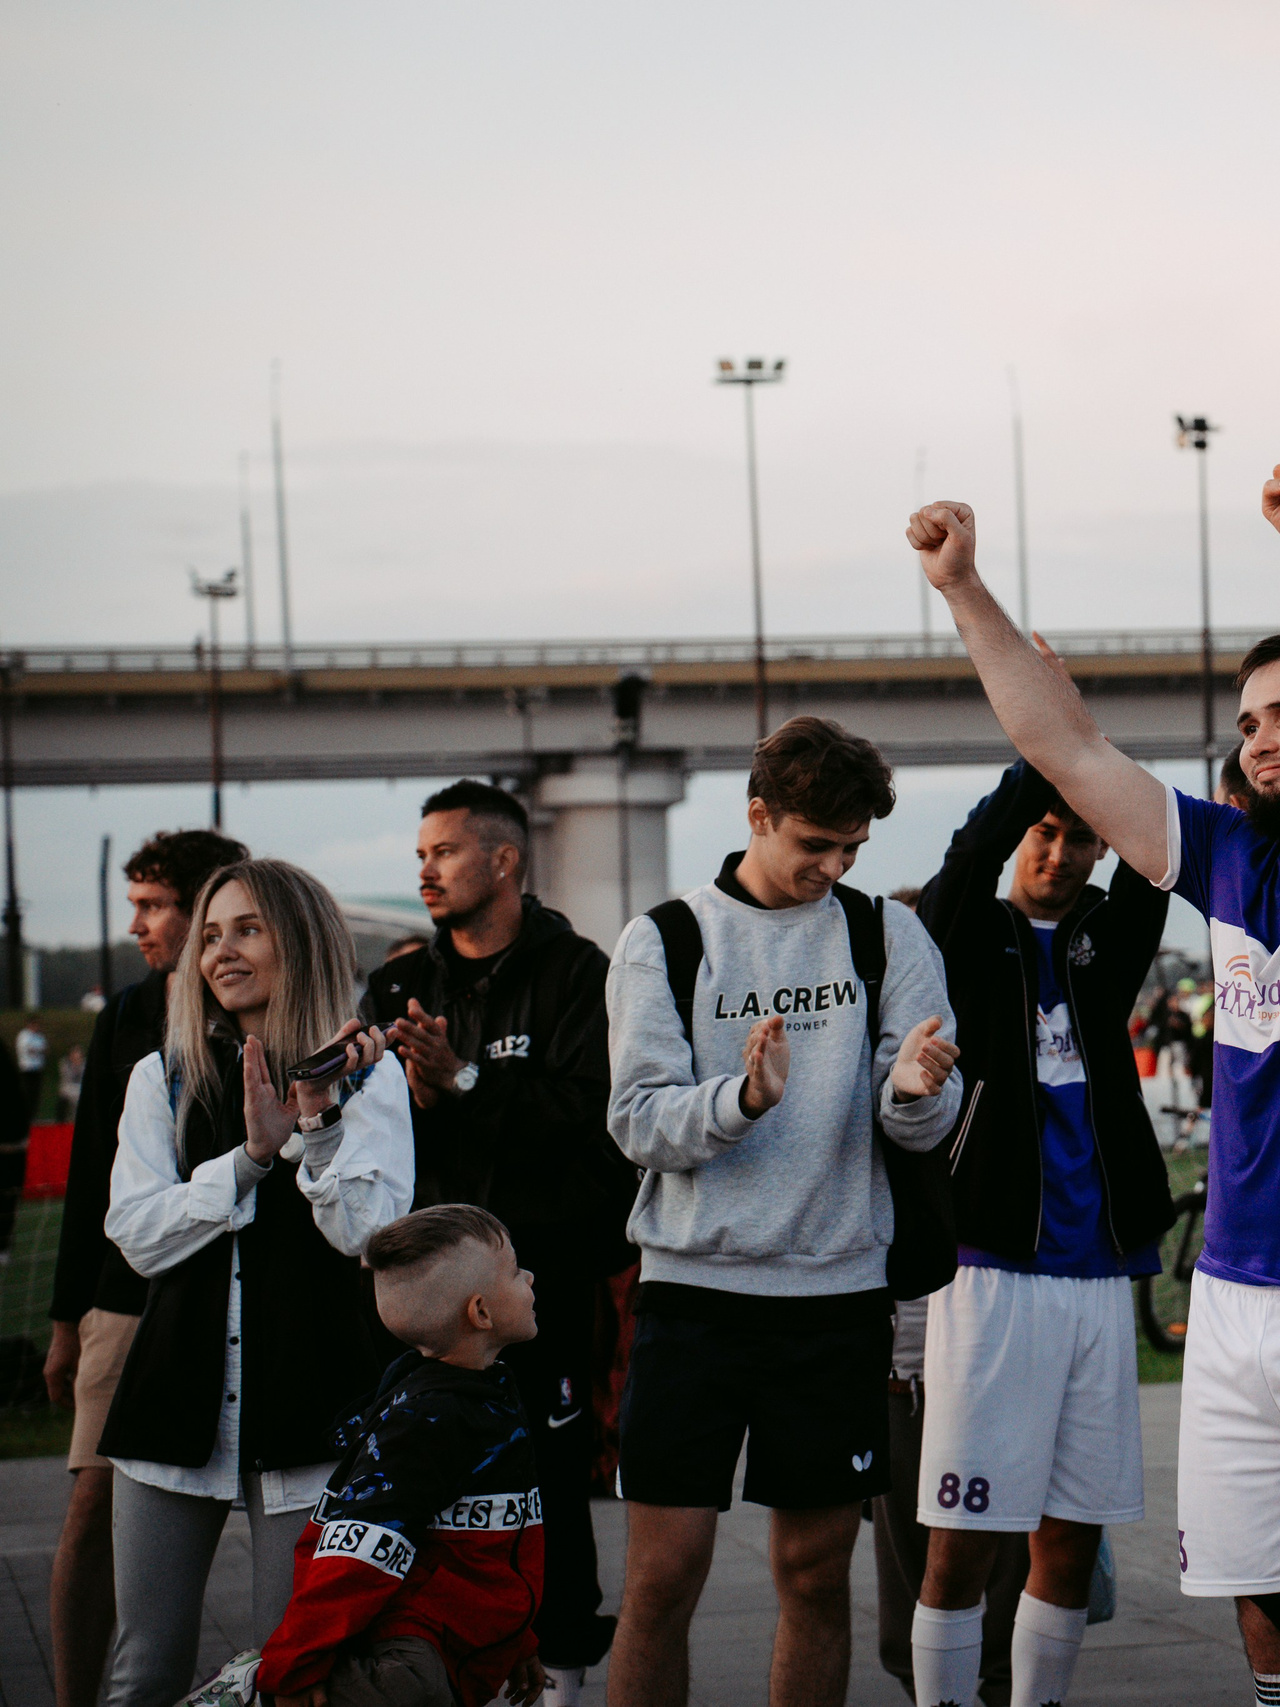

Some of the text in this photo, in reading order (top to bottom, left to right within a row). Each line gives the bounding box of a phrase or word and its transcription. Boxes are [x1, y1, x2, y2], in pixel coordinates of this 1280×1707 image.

[714, 979, 858, 1020] L.A.CREW
[786, 1019, 828, 1032] POWER
[937, 1472, 989, 1513] 88
